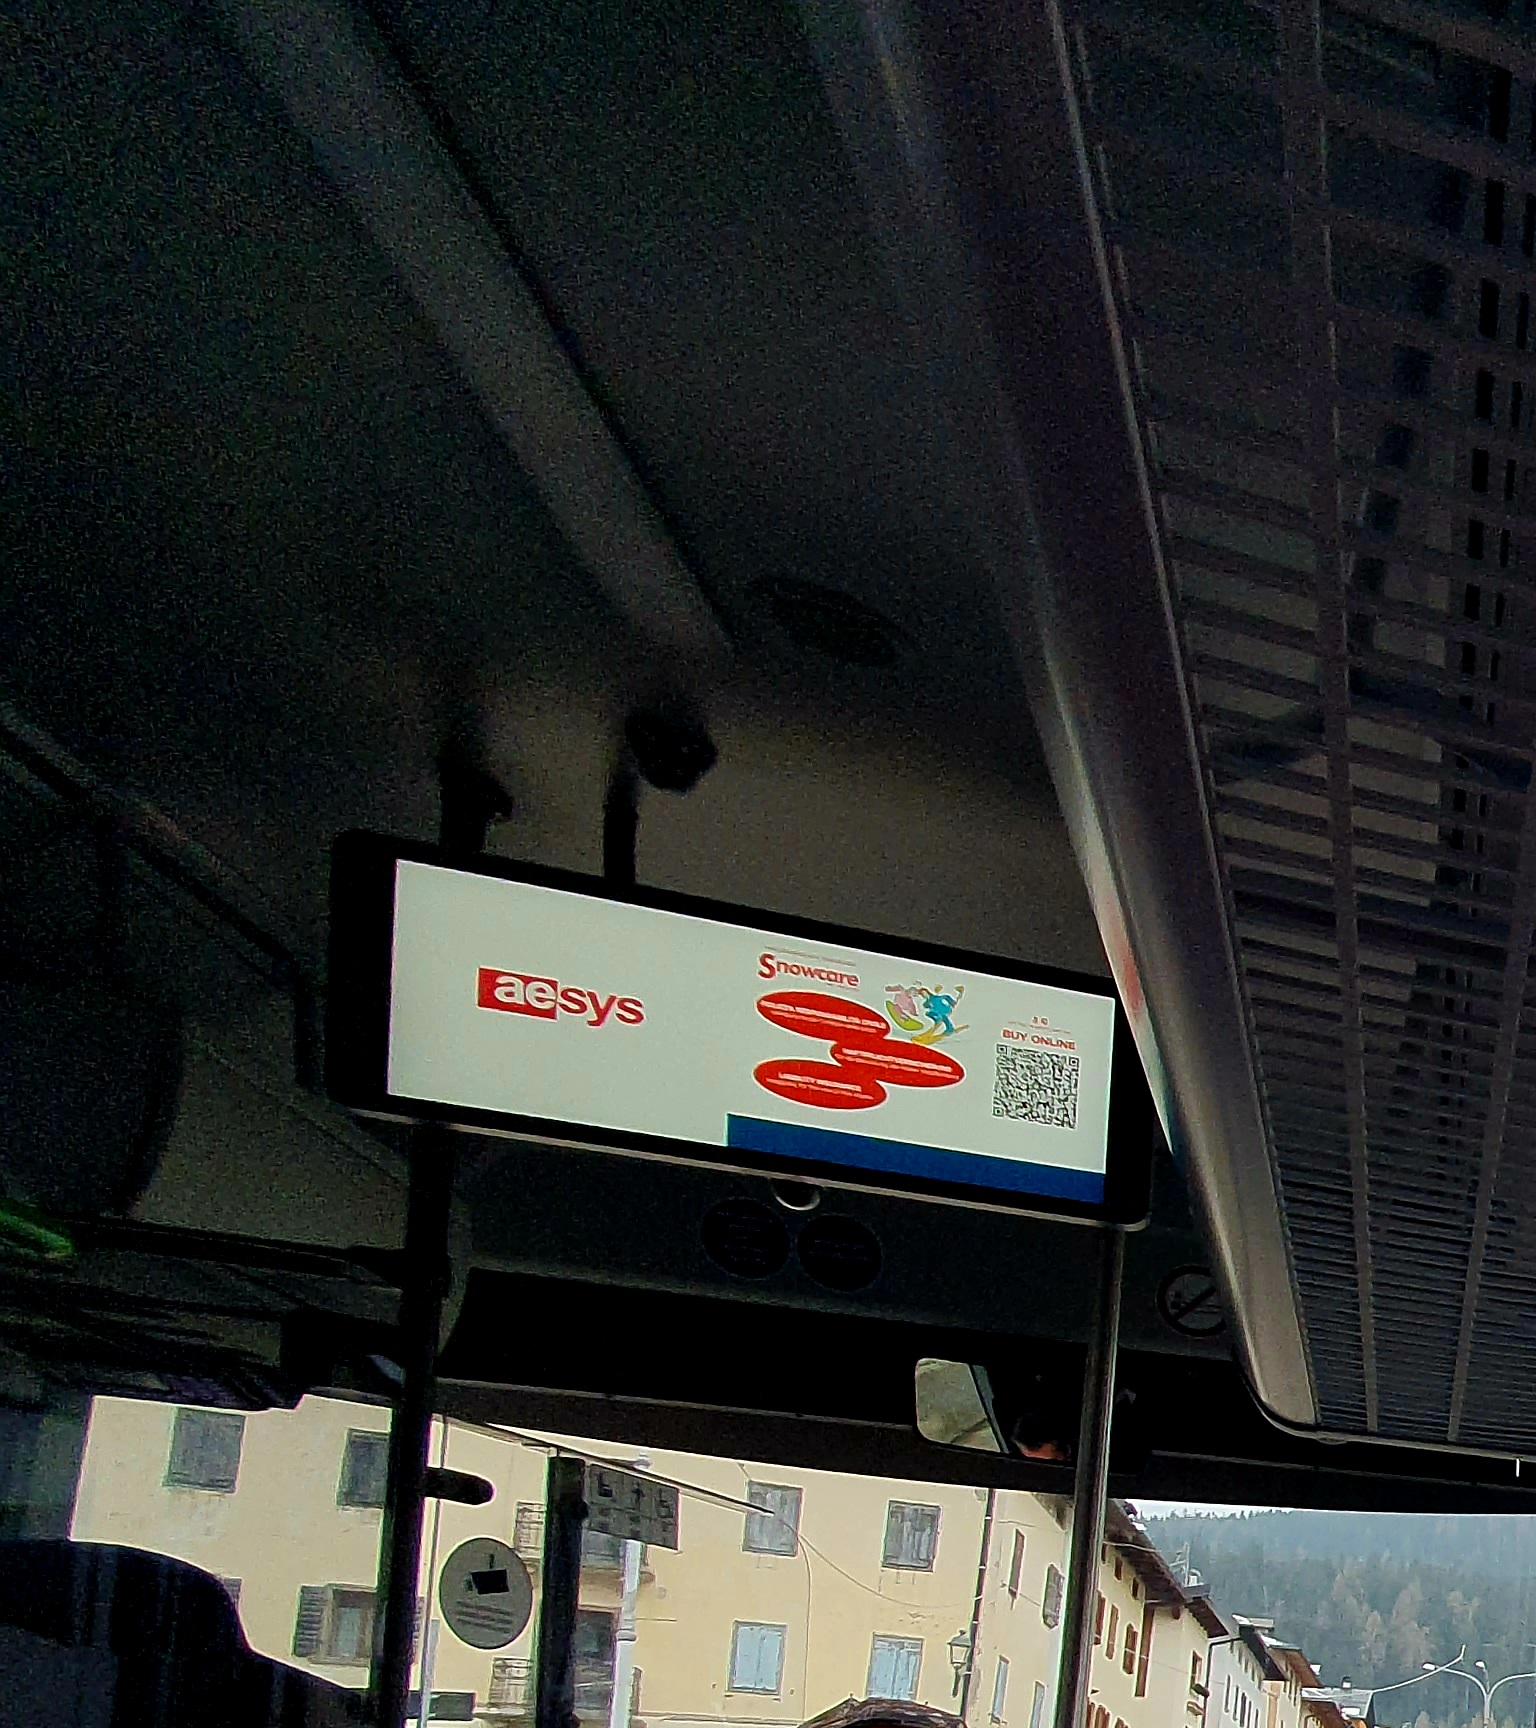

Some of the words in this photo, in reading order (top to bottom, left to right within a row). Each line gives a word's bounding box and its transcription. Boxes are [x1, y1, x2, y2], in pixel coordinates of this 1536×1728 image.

[493, 975, 645, 1027] aesys
[1002, 1029, 1028, 1041] BUY
[1030, 1034, 1076, 1050] ONLINE
